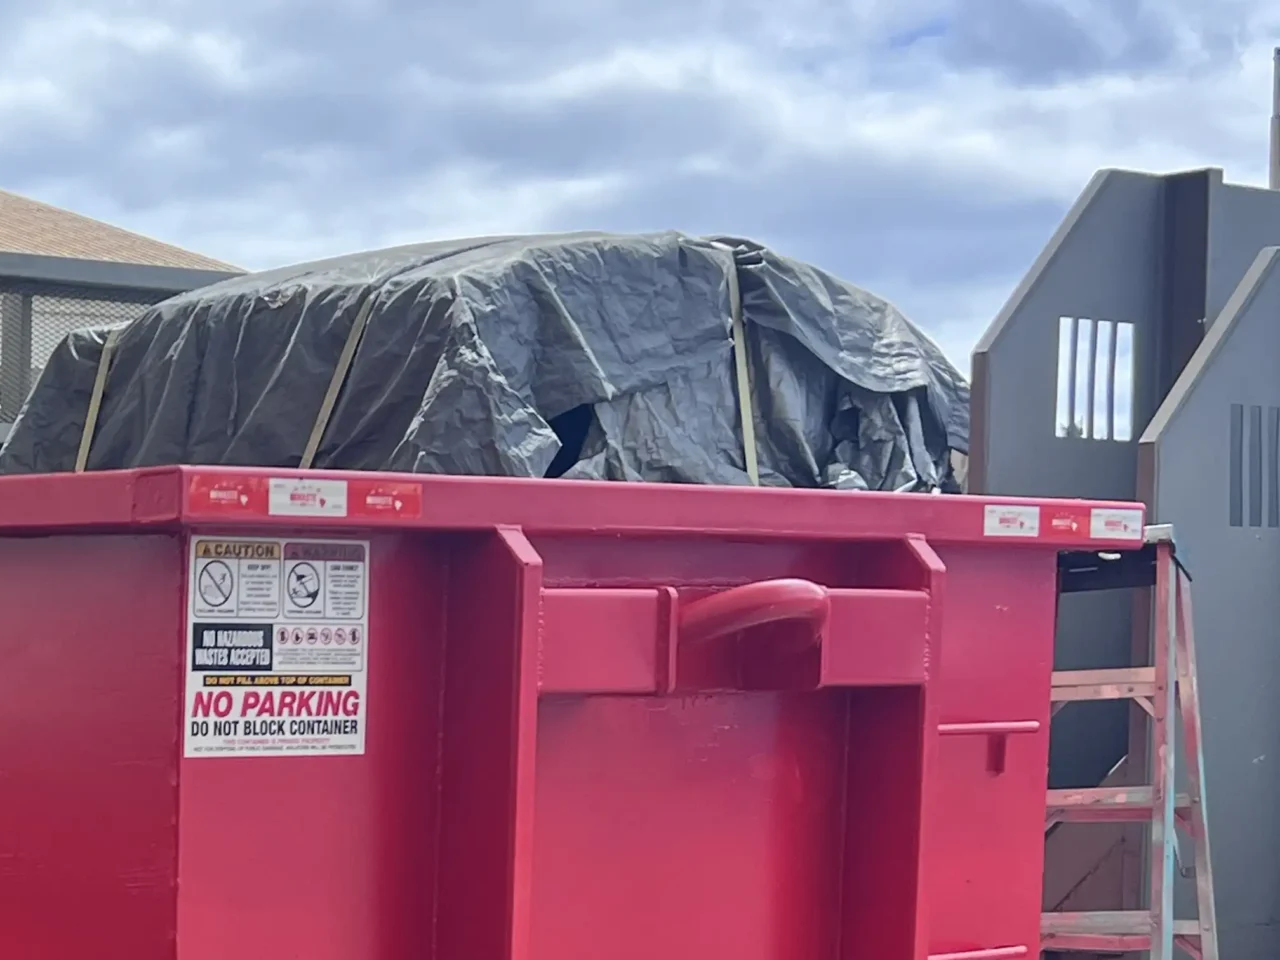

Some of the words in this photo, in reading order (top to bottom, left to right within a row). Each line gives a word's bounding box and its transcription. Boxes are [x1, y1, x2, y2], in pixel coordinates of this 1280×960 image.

[213, 544, 275, 557] CAUTION
[202, 630, 215, 647] NO
[195, 648, 229, 665] WASTES
[229, 648, 270, 665] ACCEPTED
[280, 677, 296, 685] TOP
[191, 691, 233, 718] NO
[240, 690, 360, 717] PARKING
[191, 721, 209, 736] DO
[213, 721, 239, 735] NOT
[243, 720, 286, 735] BLOCK
[289, 719, 358, 735] CONTAINER
